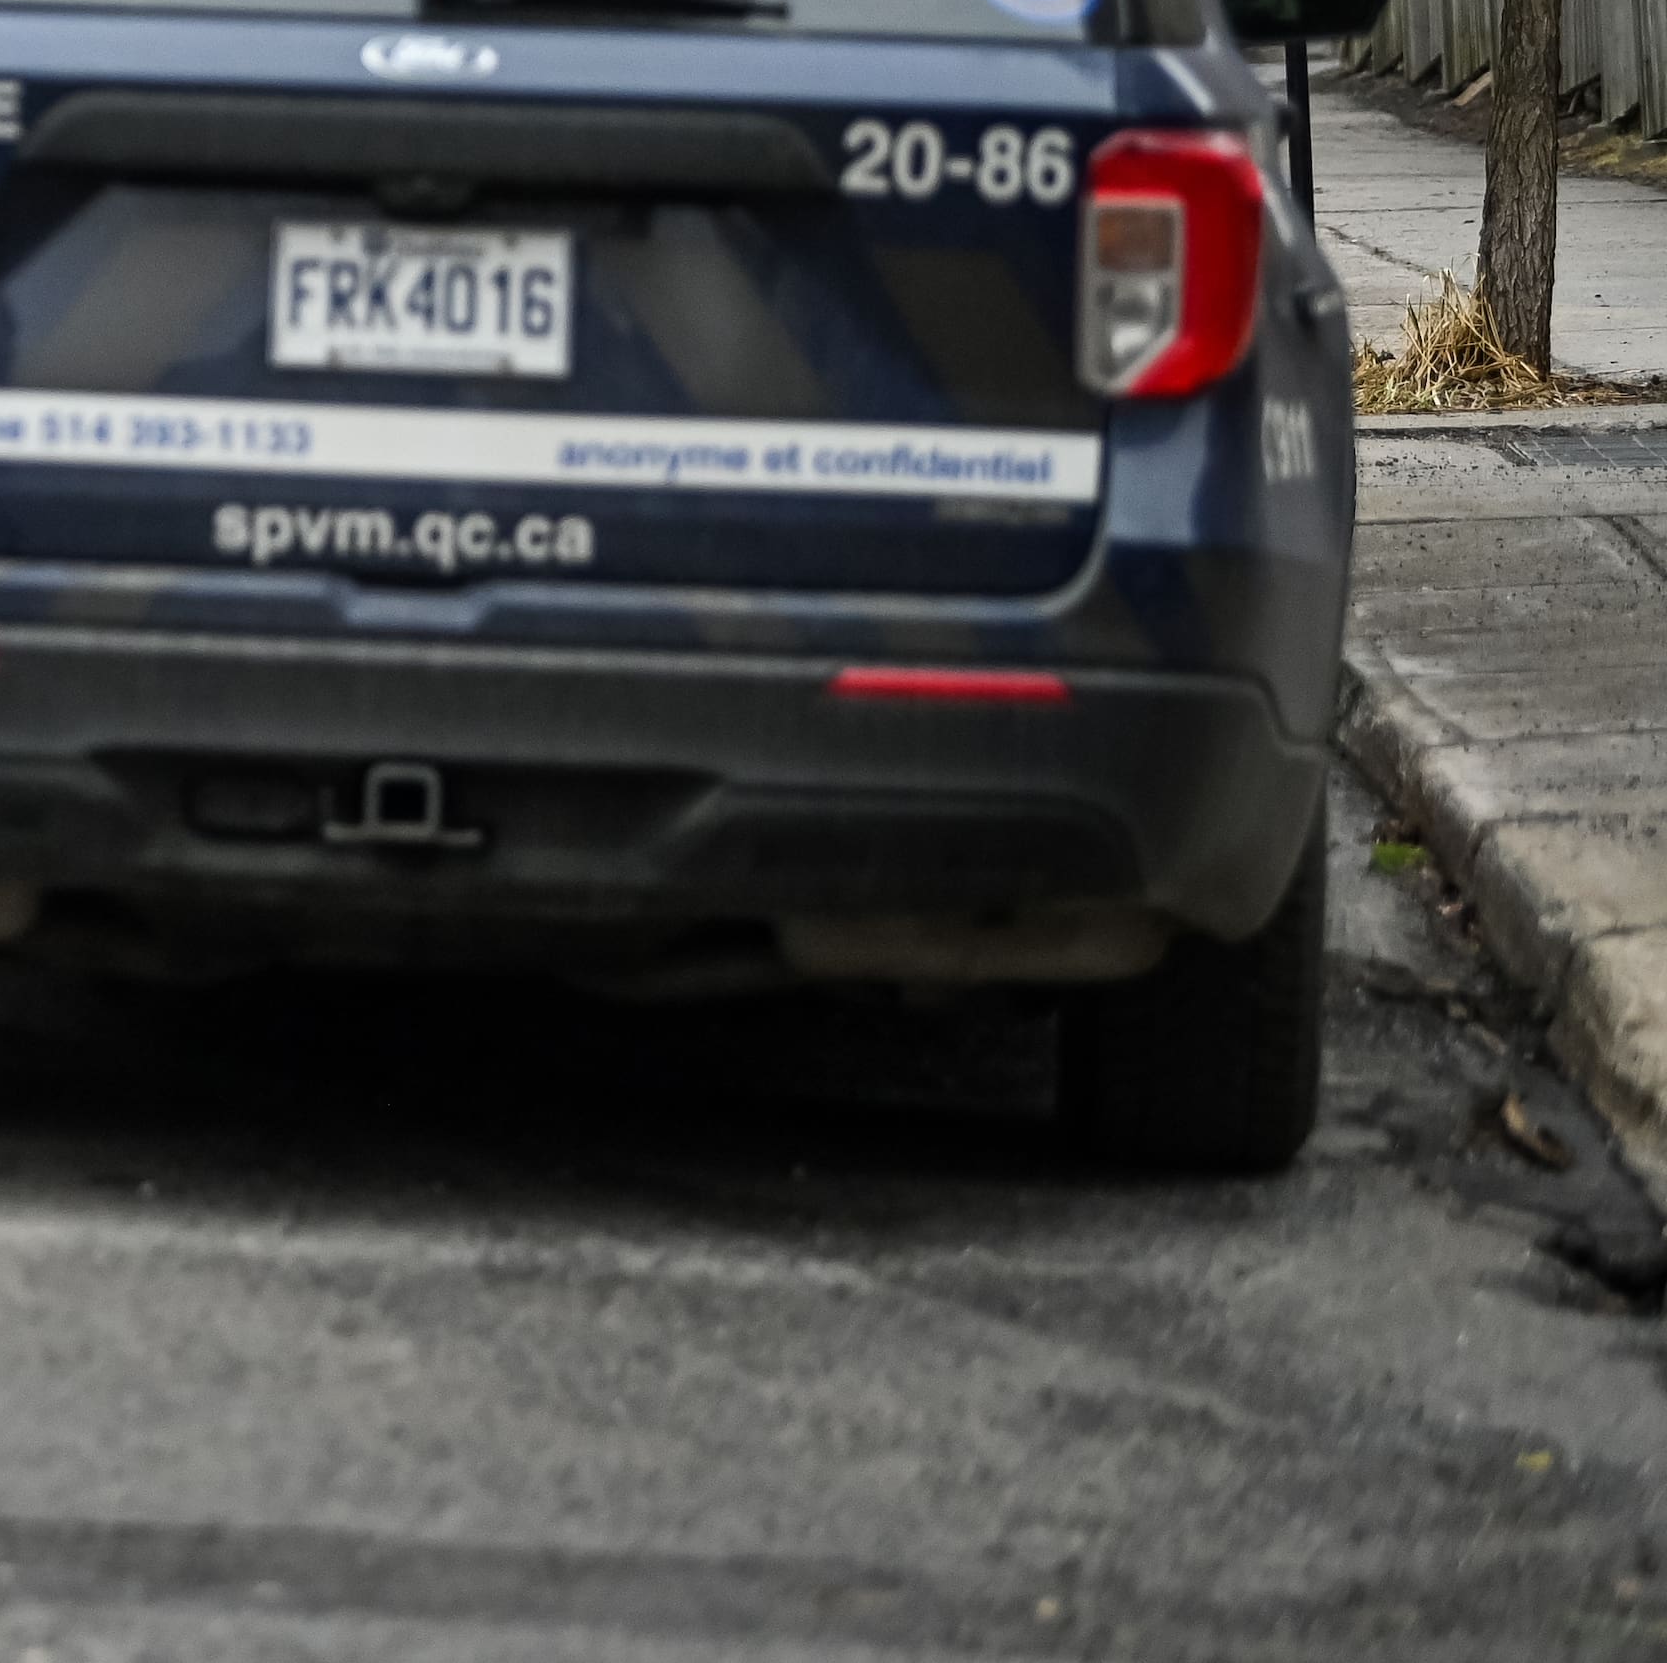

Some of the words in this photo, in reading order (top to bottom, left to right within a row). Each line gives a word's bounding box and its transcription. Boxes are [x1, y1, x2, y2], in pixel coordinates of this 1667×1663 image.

[840, 119, 1076, 204] 20-86
[288, 260, 555, 339] FRK4016
[557, 436, 751, 484] anonyme
[763, 442, 801, 476] et
[813, 442, 1054, 483] confidentiel
[213, 503, 597, 569] spvm.qc.ca
